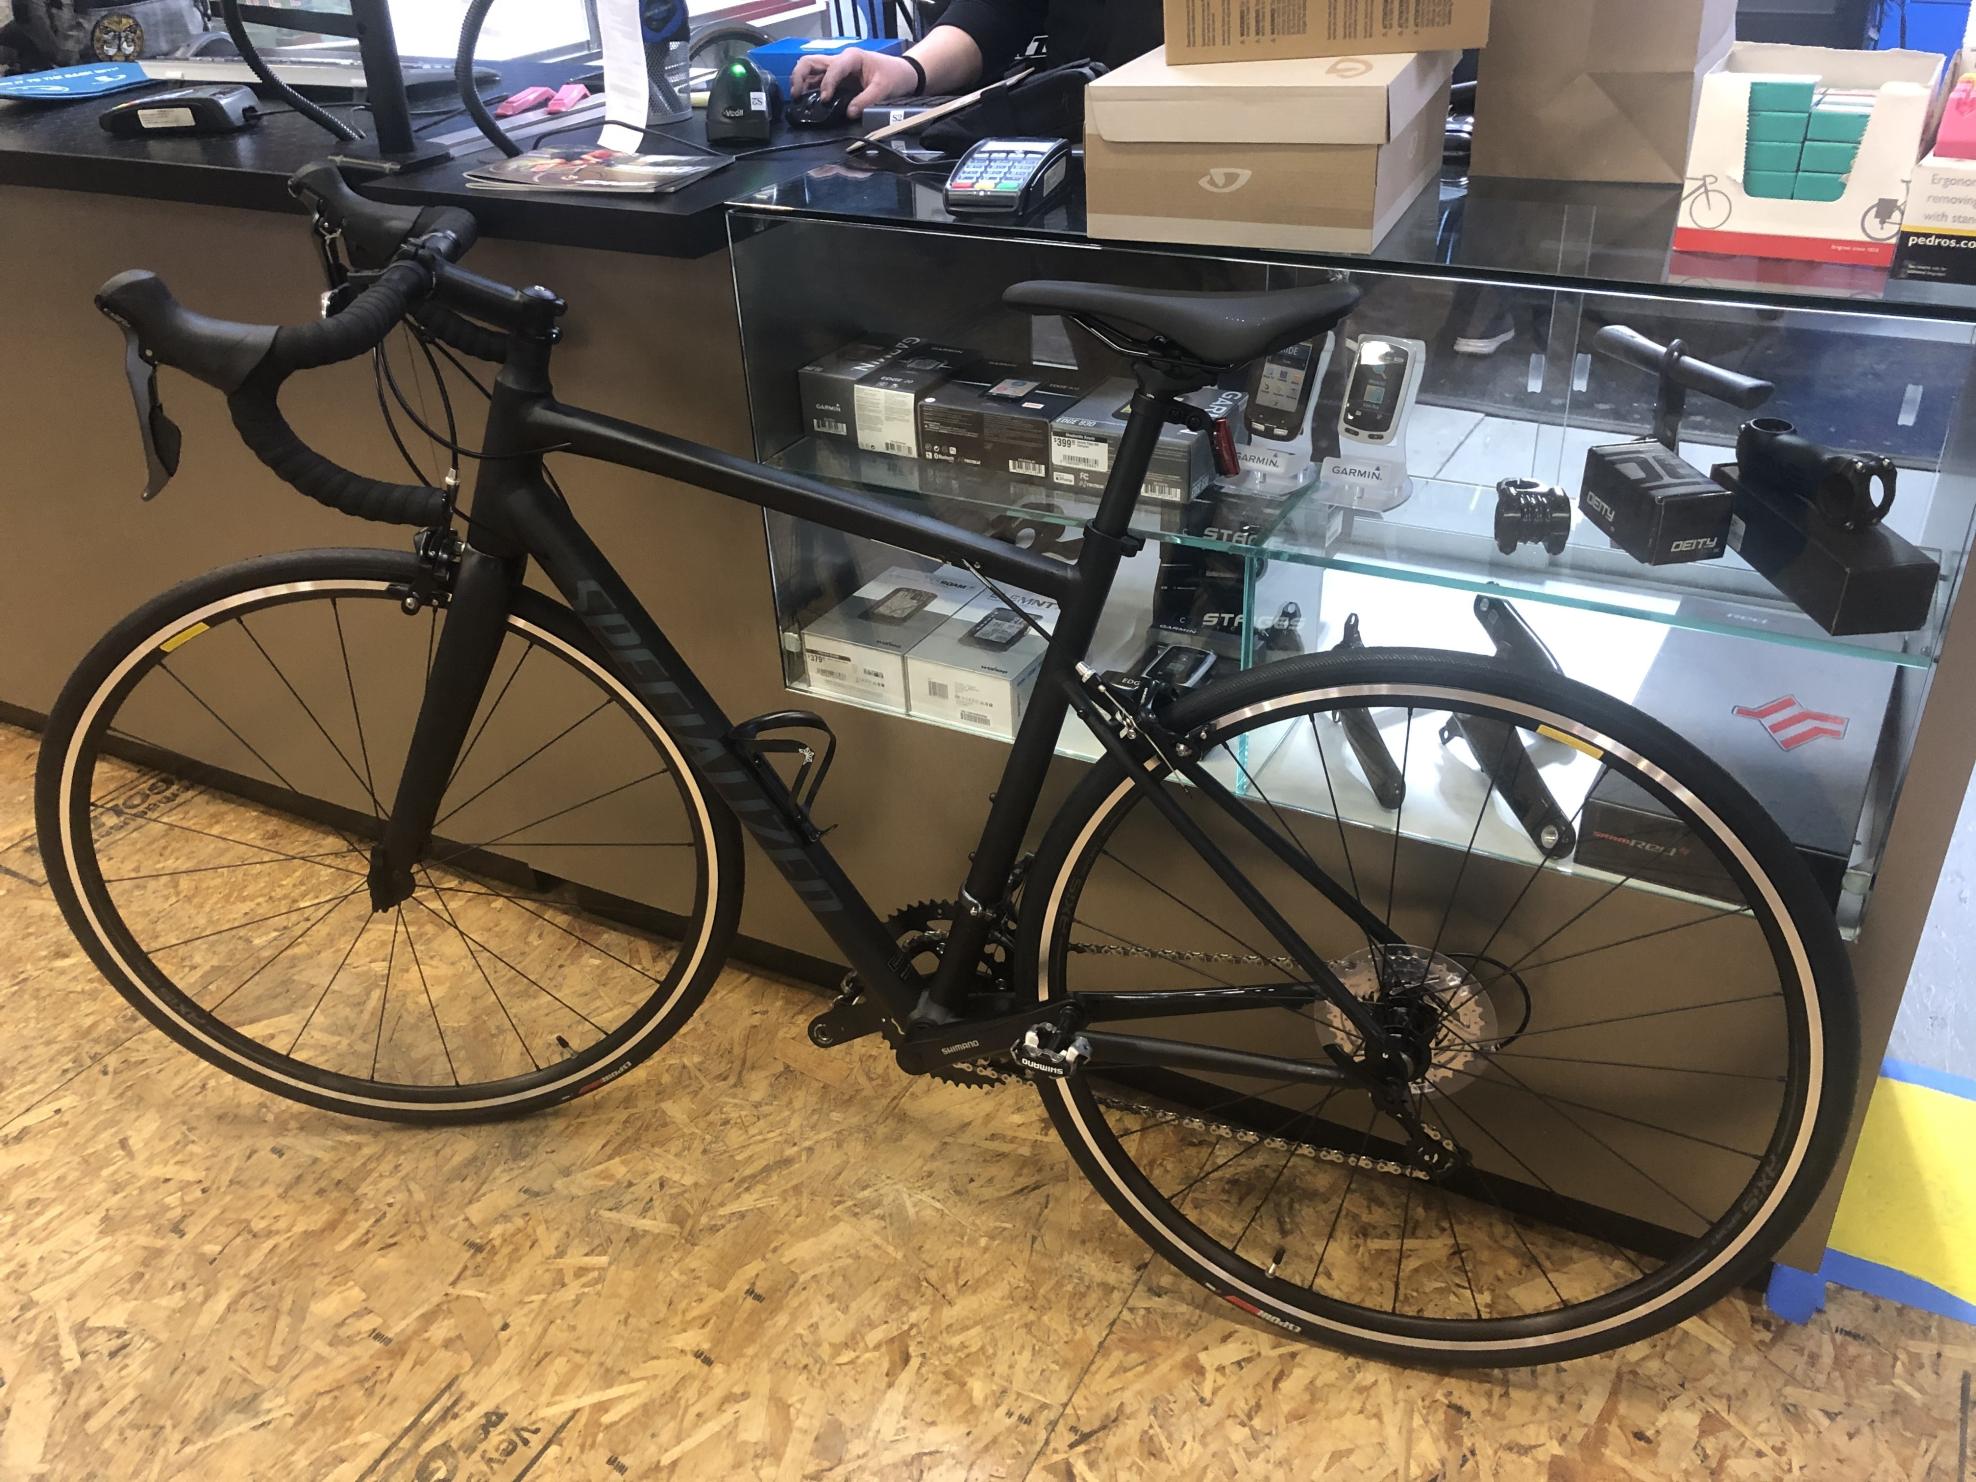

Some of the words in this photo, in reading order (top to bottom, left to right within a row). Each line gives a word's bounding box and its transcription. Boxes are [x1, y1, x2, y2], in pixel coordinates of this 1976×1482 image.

[1203, 390, 1243, 418] GAR
[1237, 451, 1280, 469] GARMIN
[1331, 464, 1383, 482] GARMIN
[1586, 491, 1616, 522] DEITY
[1670, 536, 1718, 553] DEITY
[577, 578, 846, 913] SPECIALIZED
[941, 1039, 980, 1056] SHIMANO
[1021, 1057, 1064, 1075] SHIMANO
